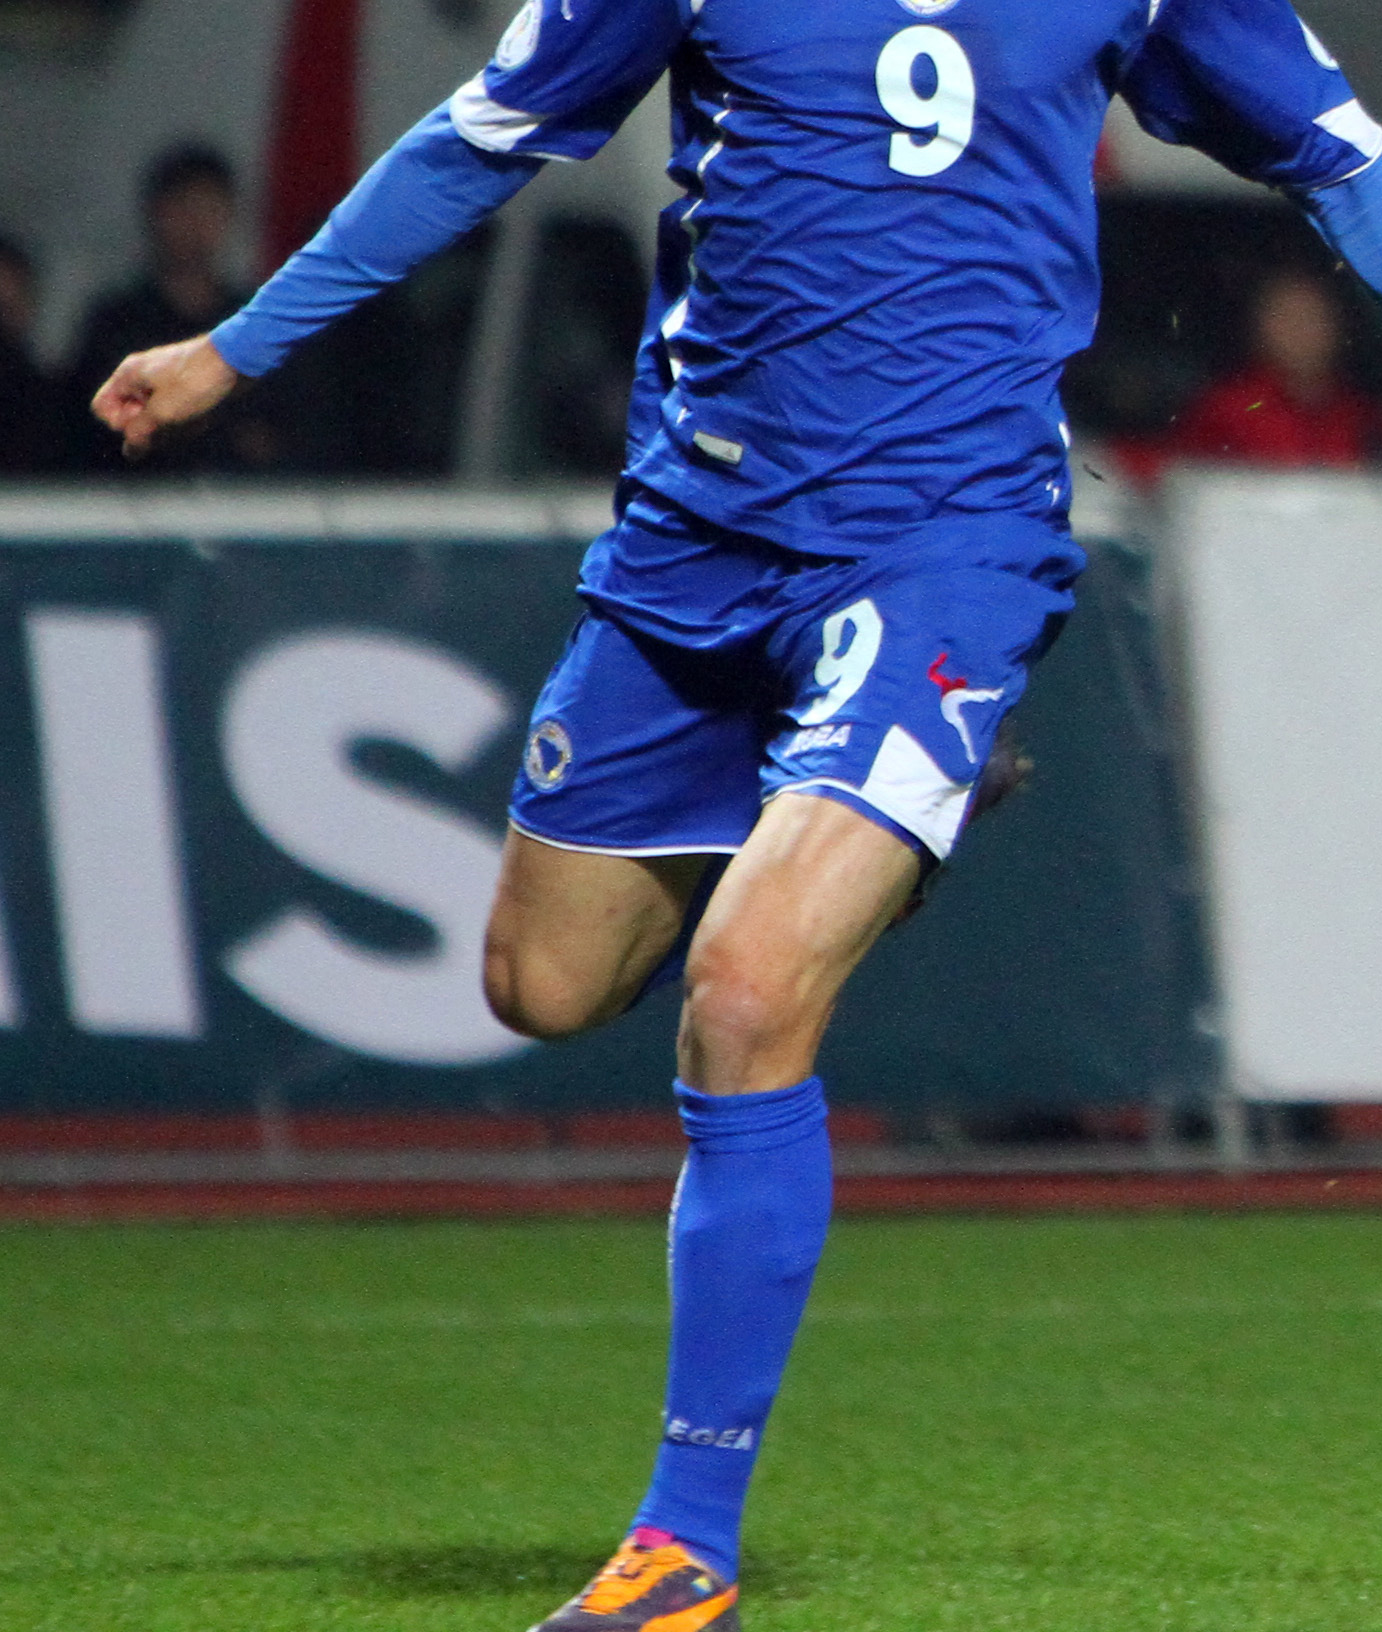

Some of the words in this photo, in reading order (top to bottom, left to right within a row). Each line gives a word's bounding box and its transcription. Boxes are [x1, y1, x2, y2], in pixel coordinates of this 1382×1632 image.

[875, 24, 976, 178] 9
[797, 597, 884, 726] 9
[0, 606, 545, 1067] IS
[666, 1418, 754, 1451] EGEA
